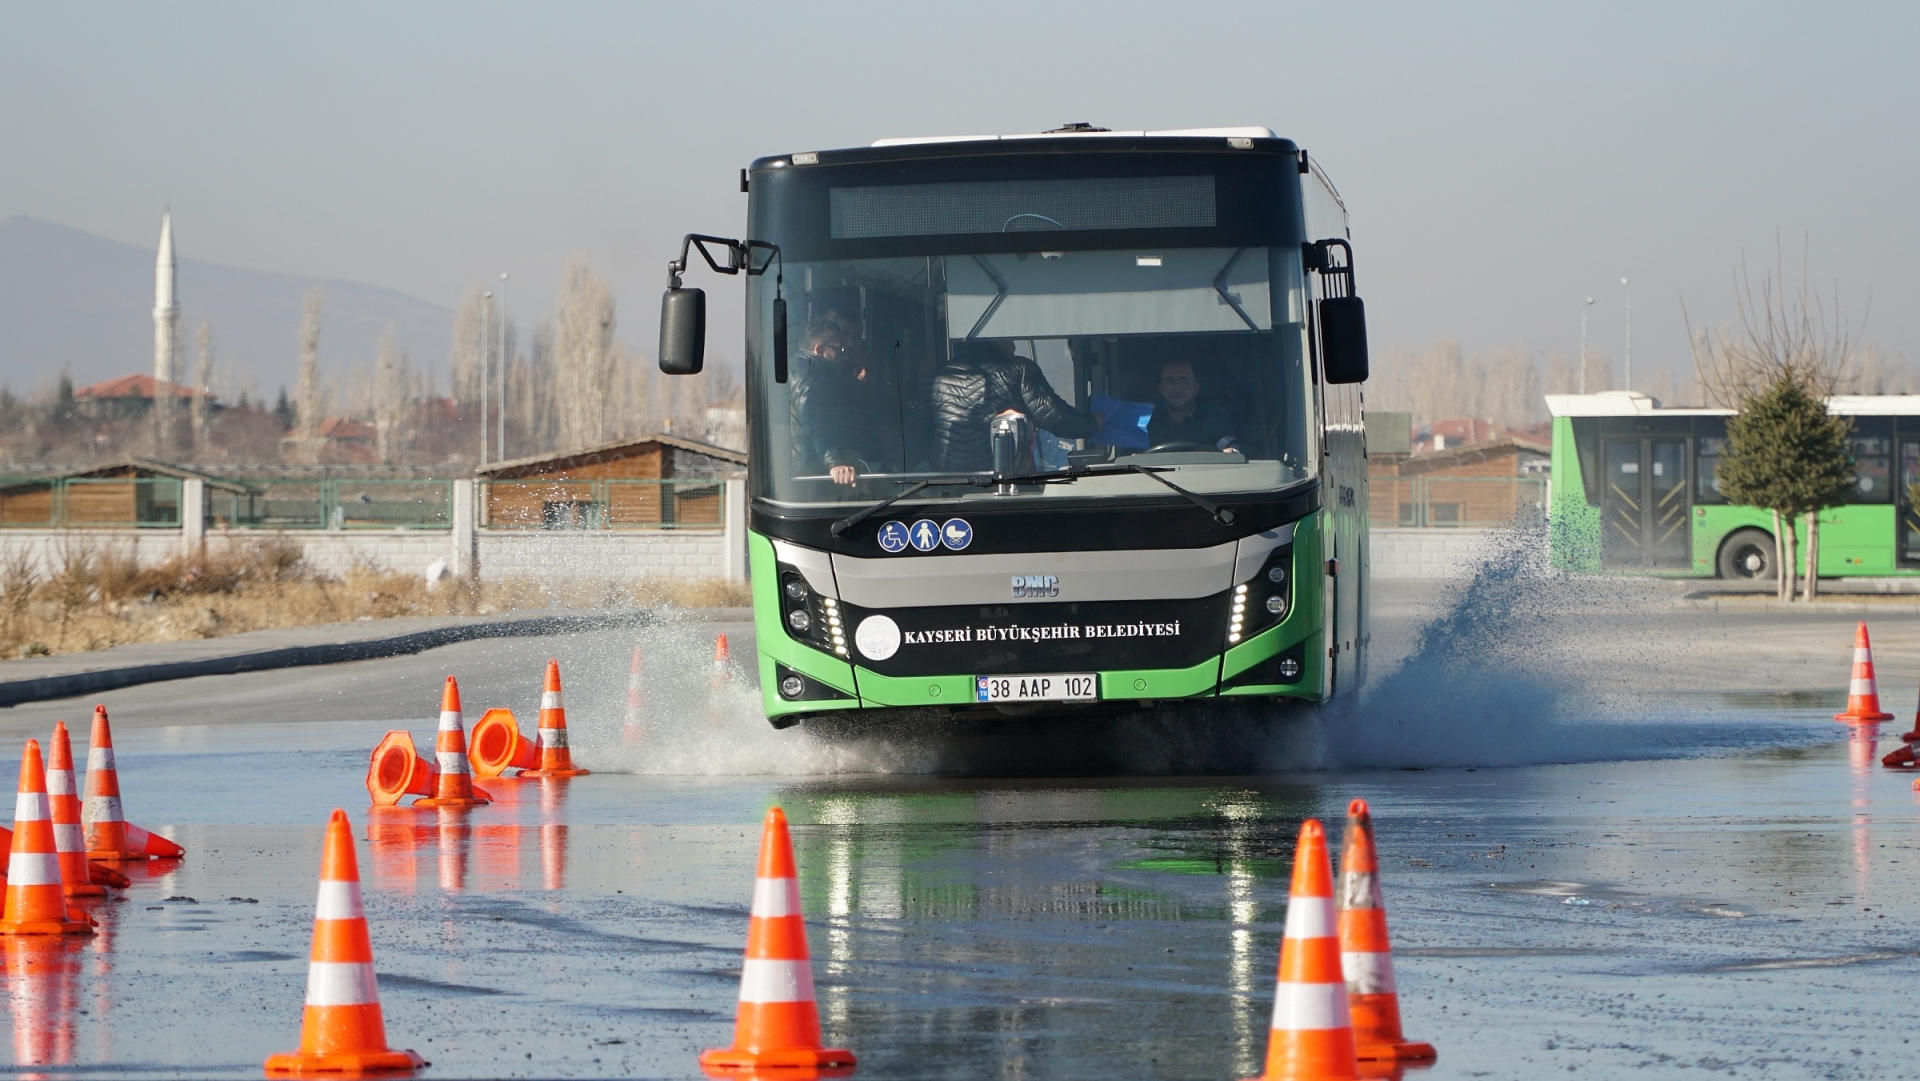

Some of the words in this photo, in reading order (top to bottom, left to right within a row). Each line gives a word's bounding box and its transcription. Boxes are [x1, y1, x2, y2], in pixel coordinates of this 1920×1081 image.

[1012, 575, 1059, 598] BMC
[904, 625, 971, 644] KAYSERİ
[976, 621, 1080, 643] BÜYÜKŞEHİR
[1085, 619, 1180, 639] BELEDİYESİ
[990, 679, 1010, 698] 38
[1018, 679, 1051, 698] AAP
[1064, 677, 1092, 697] 102
